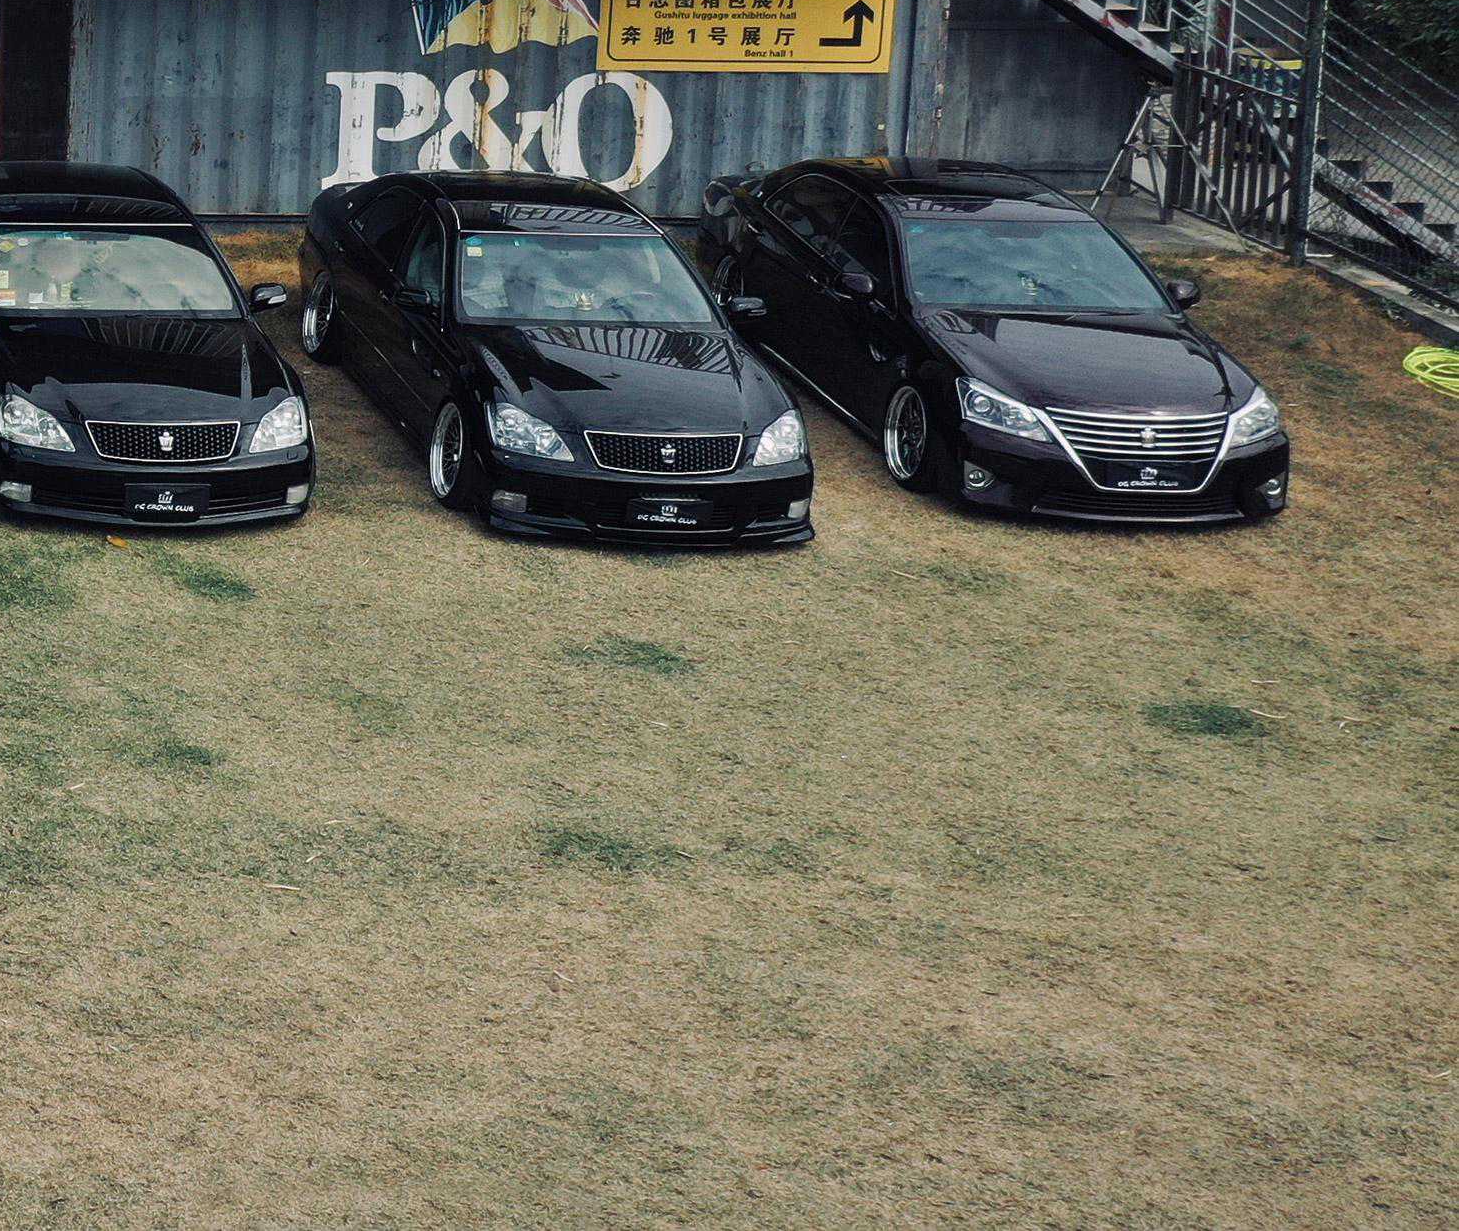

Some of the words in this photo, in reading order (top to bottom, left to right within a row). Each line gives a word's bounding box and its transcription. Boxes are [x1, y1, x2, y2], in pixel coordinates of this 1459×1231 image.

[654, 11, 690, 19] Gushitu
[692, 12, 729, 21] luggage
[731, 12, 777, 20] exhibition
[779, 12, 797, 20] hall
[621, 25, 796, 47] 奔驰1号展厅
[744, 49, 767, 58] Benz
[769, 49, 787, 58] hall
[321, 69, 673, 192] P&O
[146, 503, 173, 511] CROWN
